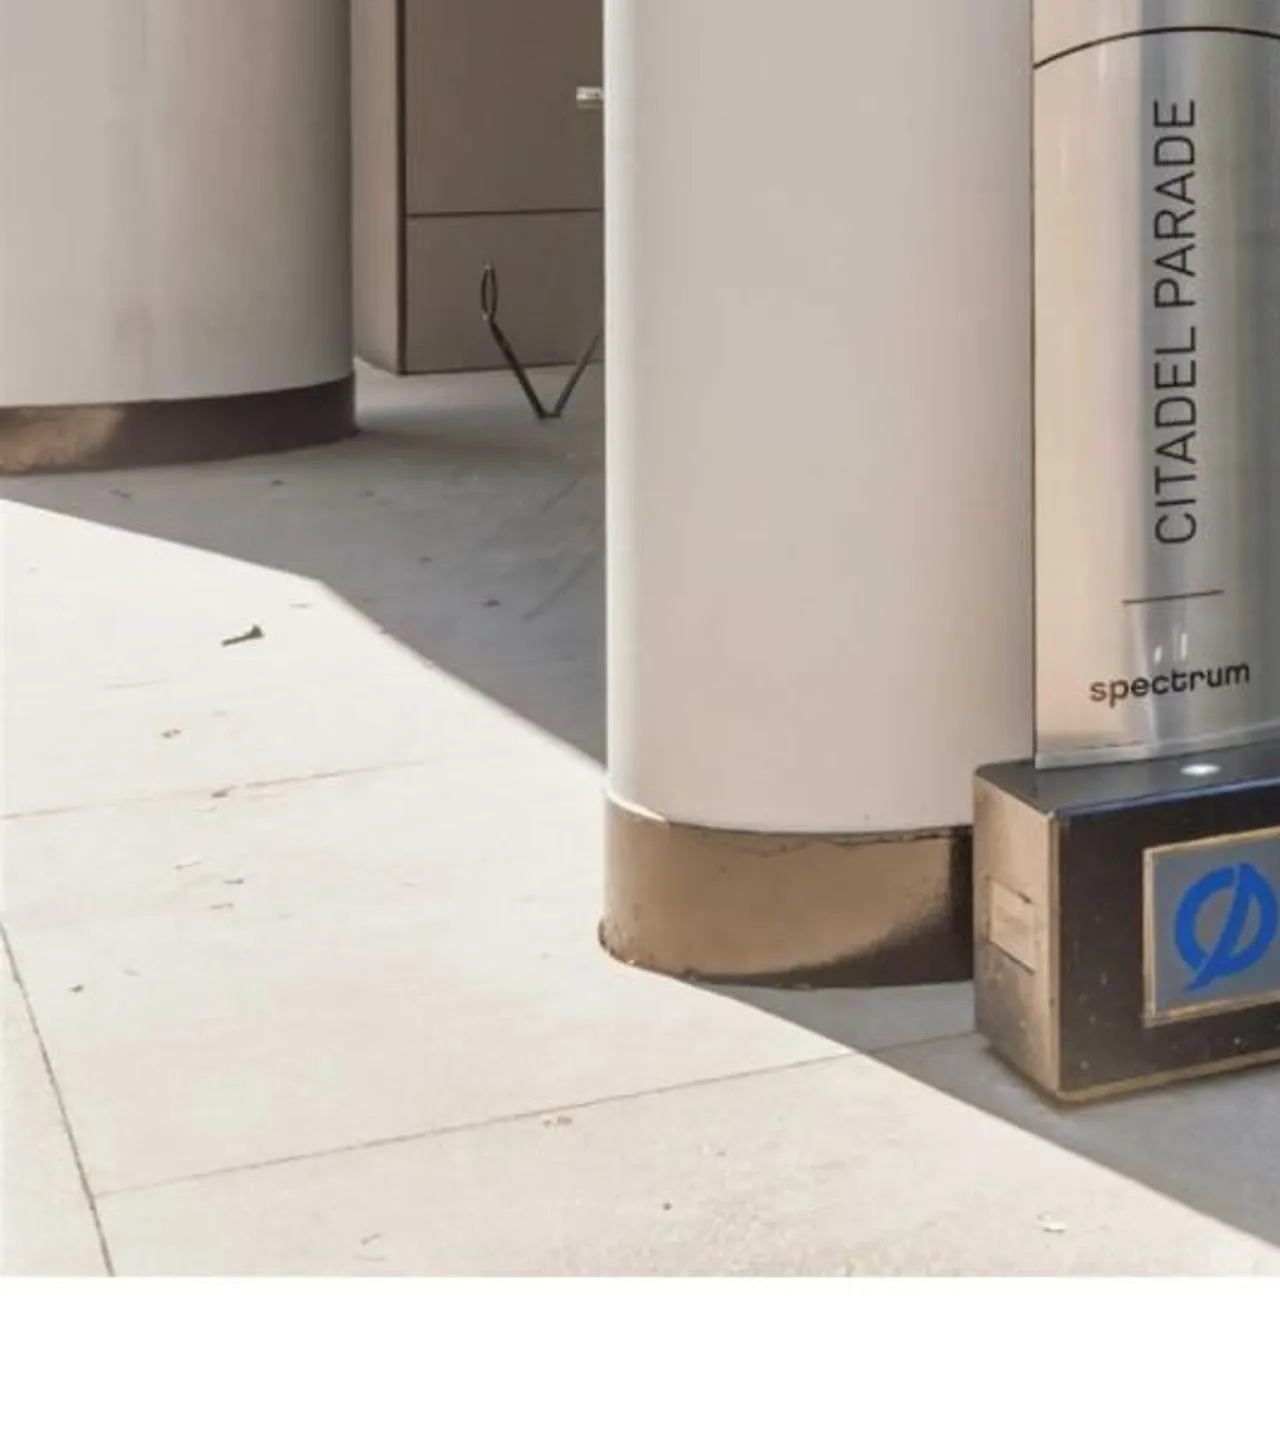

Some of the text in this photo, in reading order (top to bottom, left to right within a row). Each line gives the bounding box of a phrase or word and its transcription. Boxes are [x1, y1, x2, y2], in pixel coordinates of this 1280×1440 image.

[1152, 99, 1197, 545] CITADEL PARADE
[1088, 662, 1250, 709] spectrum
